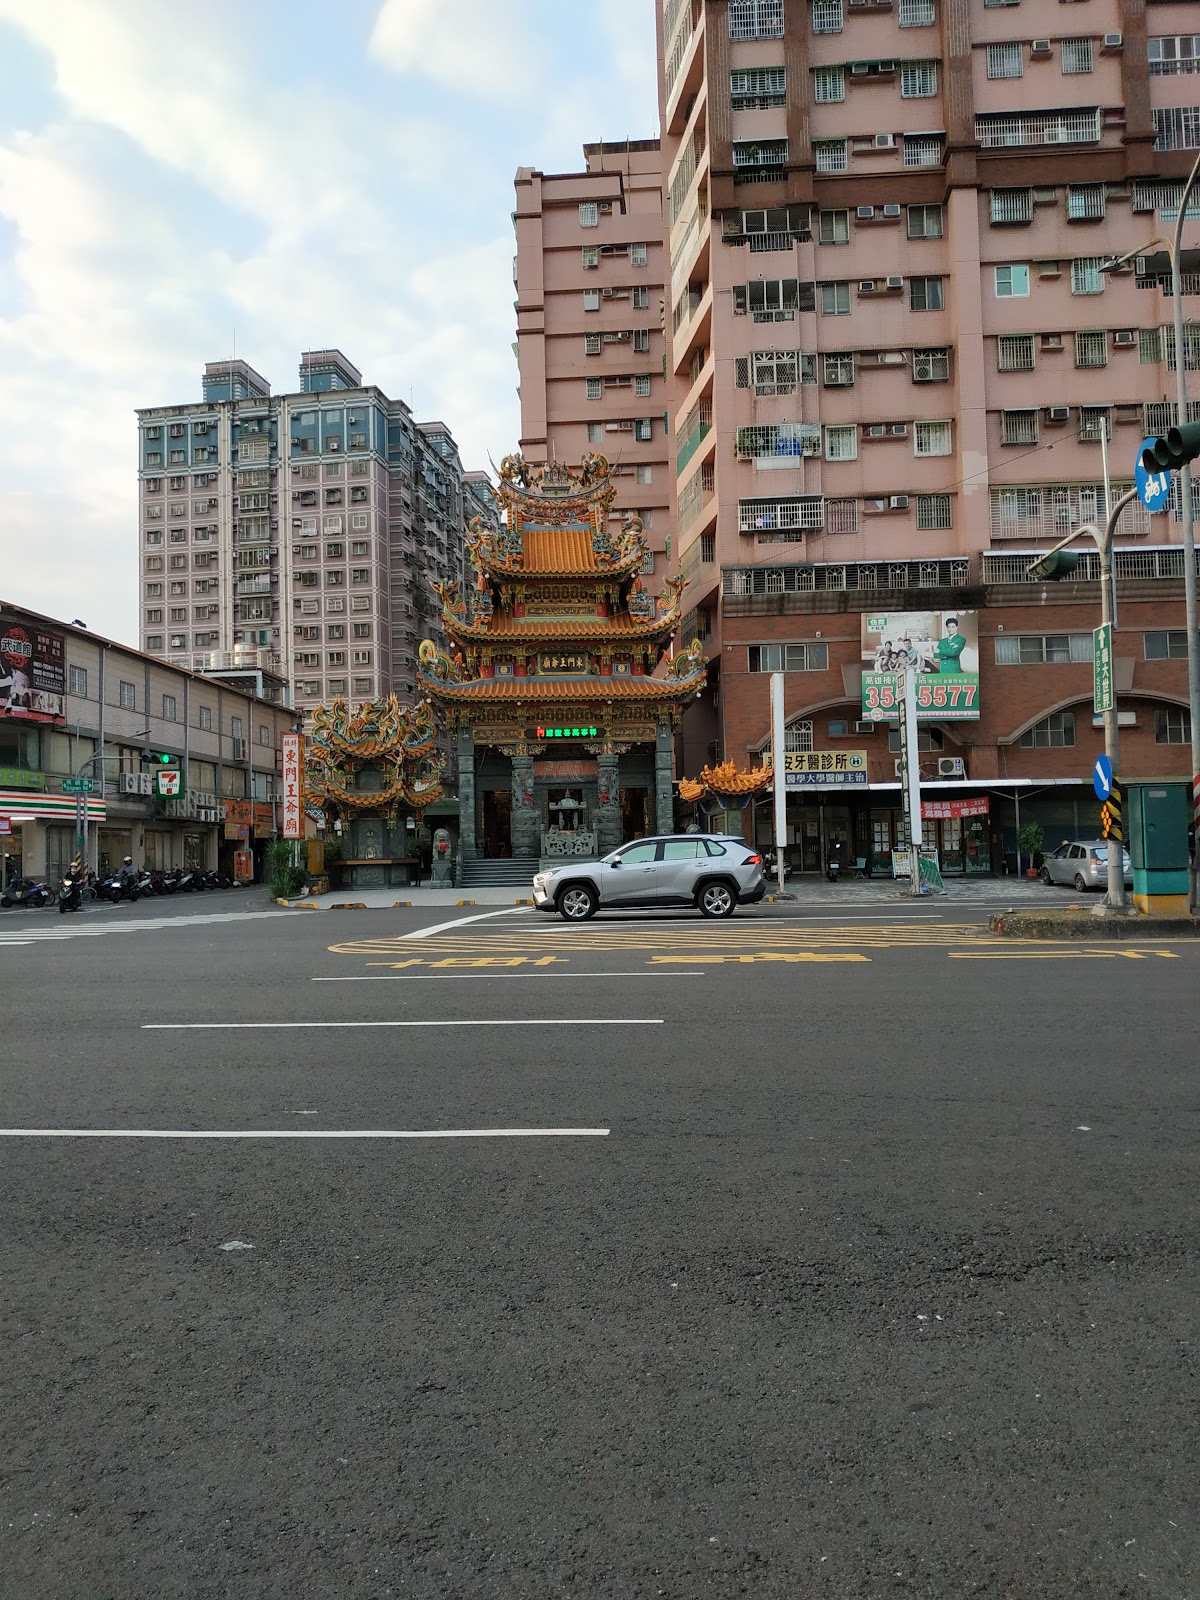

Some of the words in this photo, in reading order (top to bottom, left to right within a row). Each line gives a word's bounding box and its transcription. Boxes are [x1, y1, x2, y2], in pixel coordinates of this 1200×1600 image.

[1, 638, 32, 658] 武道館
[543, 656, 583, 668] 東門王爺廟
[786, 773, 864, 783] 醫學大學醫師主治
[285, 749, 298, 833] 東門王爺廟
